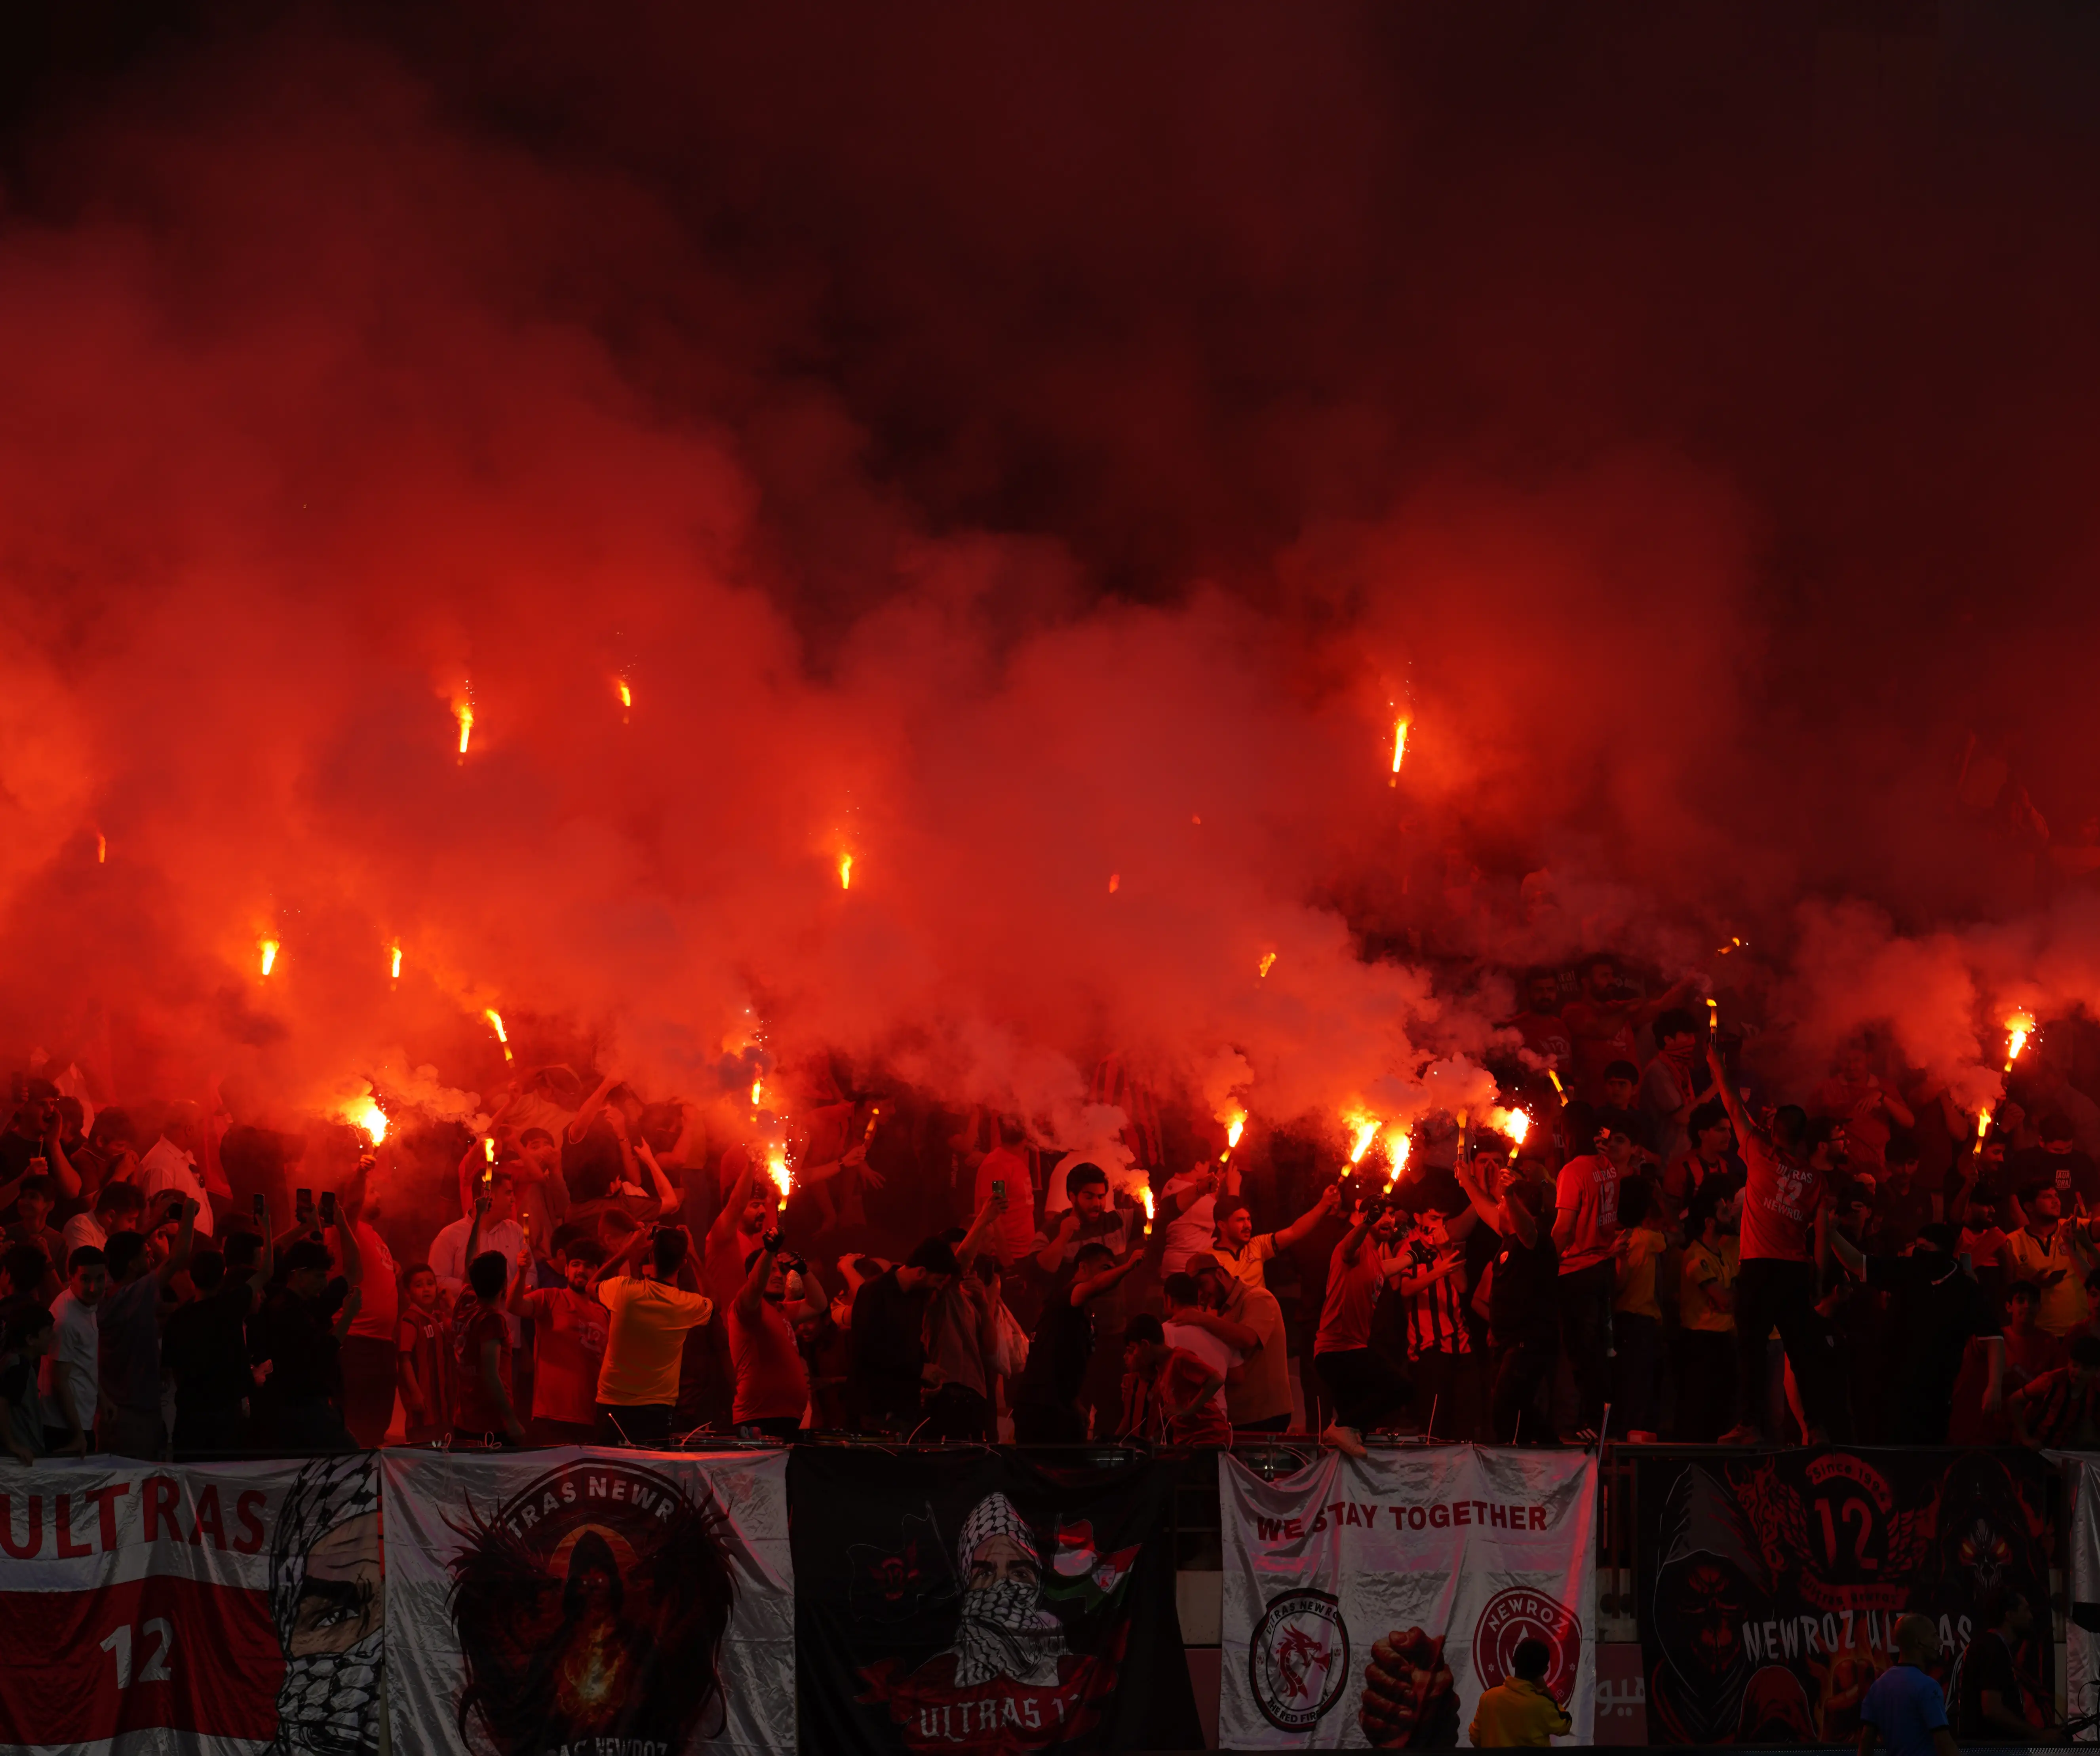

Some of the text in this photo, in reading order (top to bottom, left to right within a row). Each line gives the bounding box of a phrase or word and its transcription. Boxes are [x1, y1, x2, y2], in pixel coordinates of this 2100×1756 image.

[1592, 1167, 1617, 1183] ULRAS
[1776, 1176, 1803, 1207] 12
[1600, 1181, 1615, 1214] 12
[424, 1325, 434, 1339] 10
[588, 1327, 601, 1341] 12
[0, 1476, 267, 1559] ULTRAS
[497, 1481, 576, 1539] TRAS
[1257, 1501, 1547, 1541] WE STAY TOGETHER
[1814, 1497, 1878, 1569] 12
[1488, 1598, 1569, 1633] NEWROZ
[100, 1617, 173, 1689] 12
[1742, 1610, 1972, 1663] NEWROZ ULAS
[920, 1693, 1079, 1743] ULTRAS 1
[1267, 1697, 1281, 1714] THE
[1280, 1710, 1298, 1722] RED
